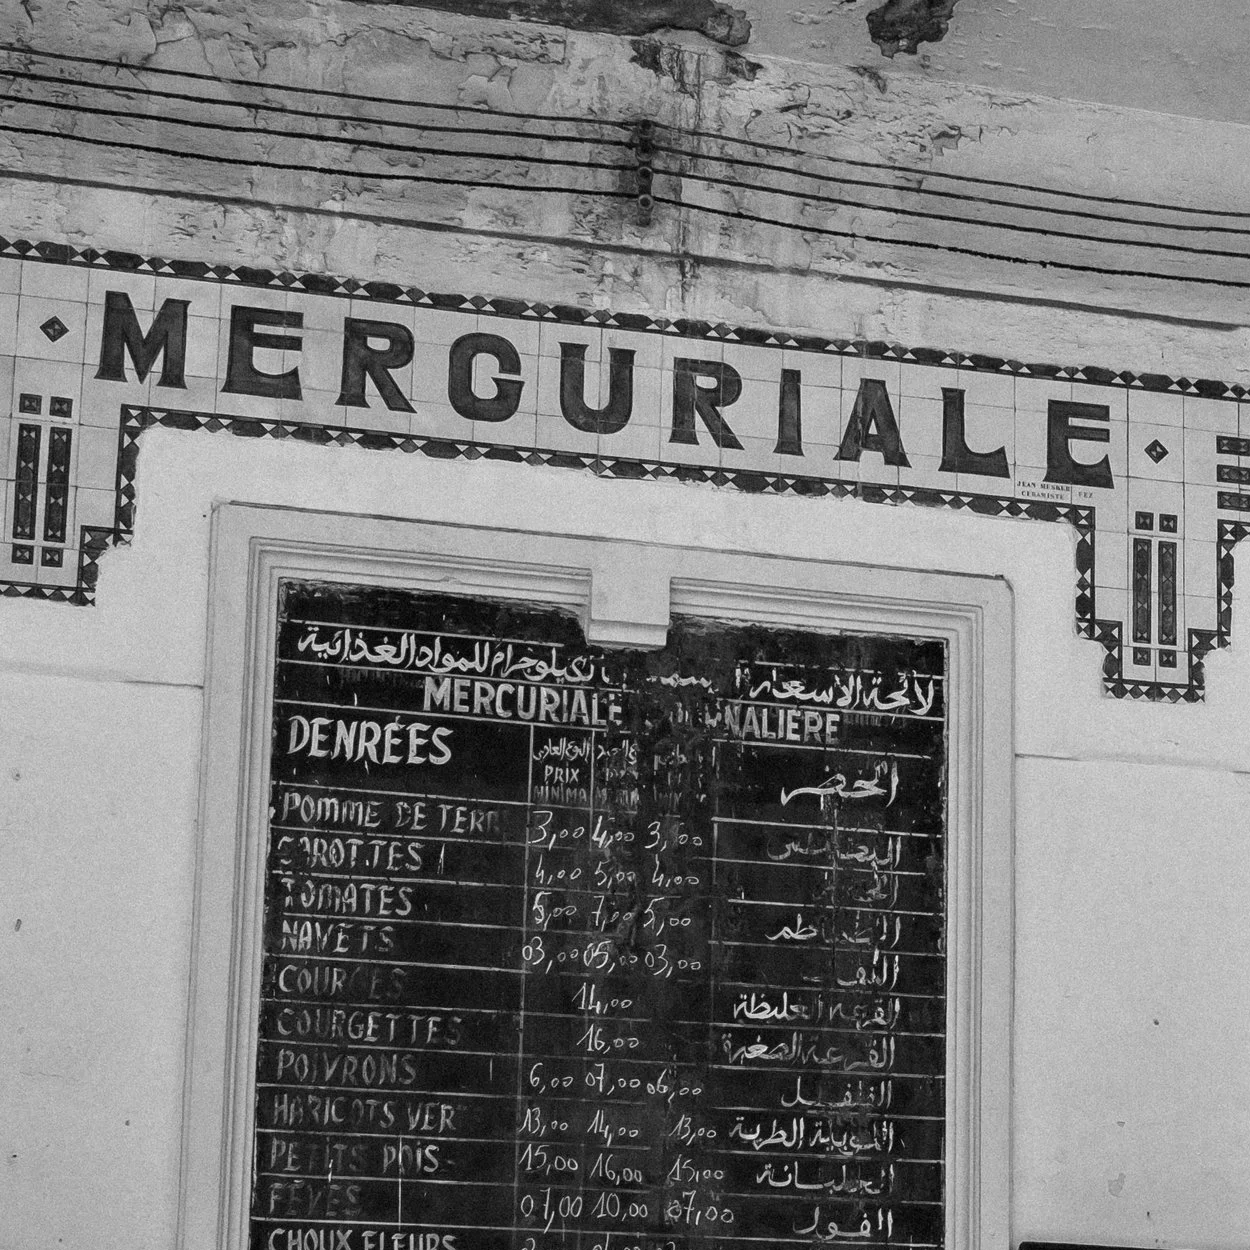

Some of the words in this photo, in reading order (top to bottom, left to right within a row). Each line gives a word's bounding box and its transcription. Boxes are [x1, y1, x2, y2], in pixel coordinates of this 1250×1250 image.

[94, 290, 1115, 489] MERCURIALE
[423, 676, 622, 726] MERCURIALE
[287, 715, 454, 765] DENRÉES
[544, 762, 580, 784] PRIX
[281, 791, 384, 828] POMME
[536, 853, 582, 885] 4,00
[652, 854, 700, 888] 4,00
[281, 919, 395, 953] NAVETS
[571, 982, 633, 1015] 14,00
[576, 1023, 640, 1055] 16,00
[277, 1048, 417, 1086] POIVRONS
[530, 1062, 574, 1094] 6,00
[585, 1063, 641, 1096] 07,00
[518, 1106, 569, 1137] 13,00
[587, 1109, 639, 1148] 14,00
[668, 1114, 717, 1147] 13,00
[518, 1143, 579, 1176] 15,00
[589, 1152, 643, 1186] 16,00
[667, 1153, 725, 1183] 15,00
[591, 1191, 649, 1223] 10,00
